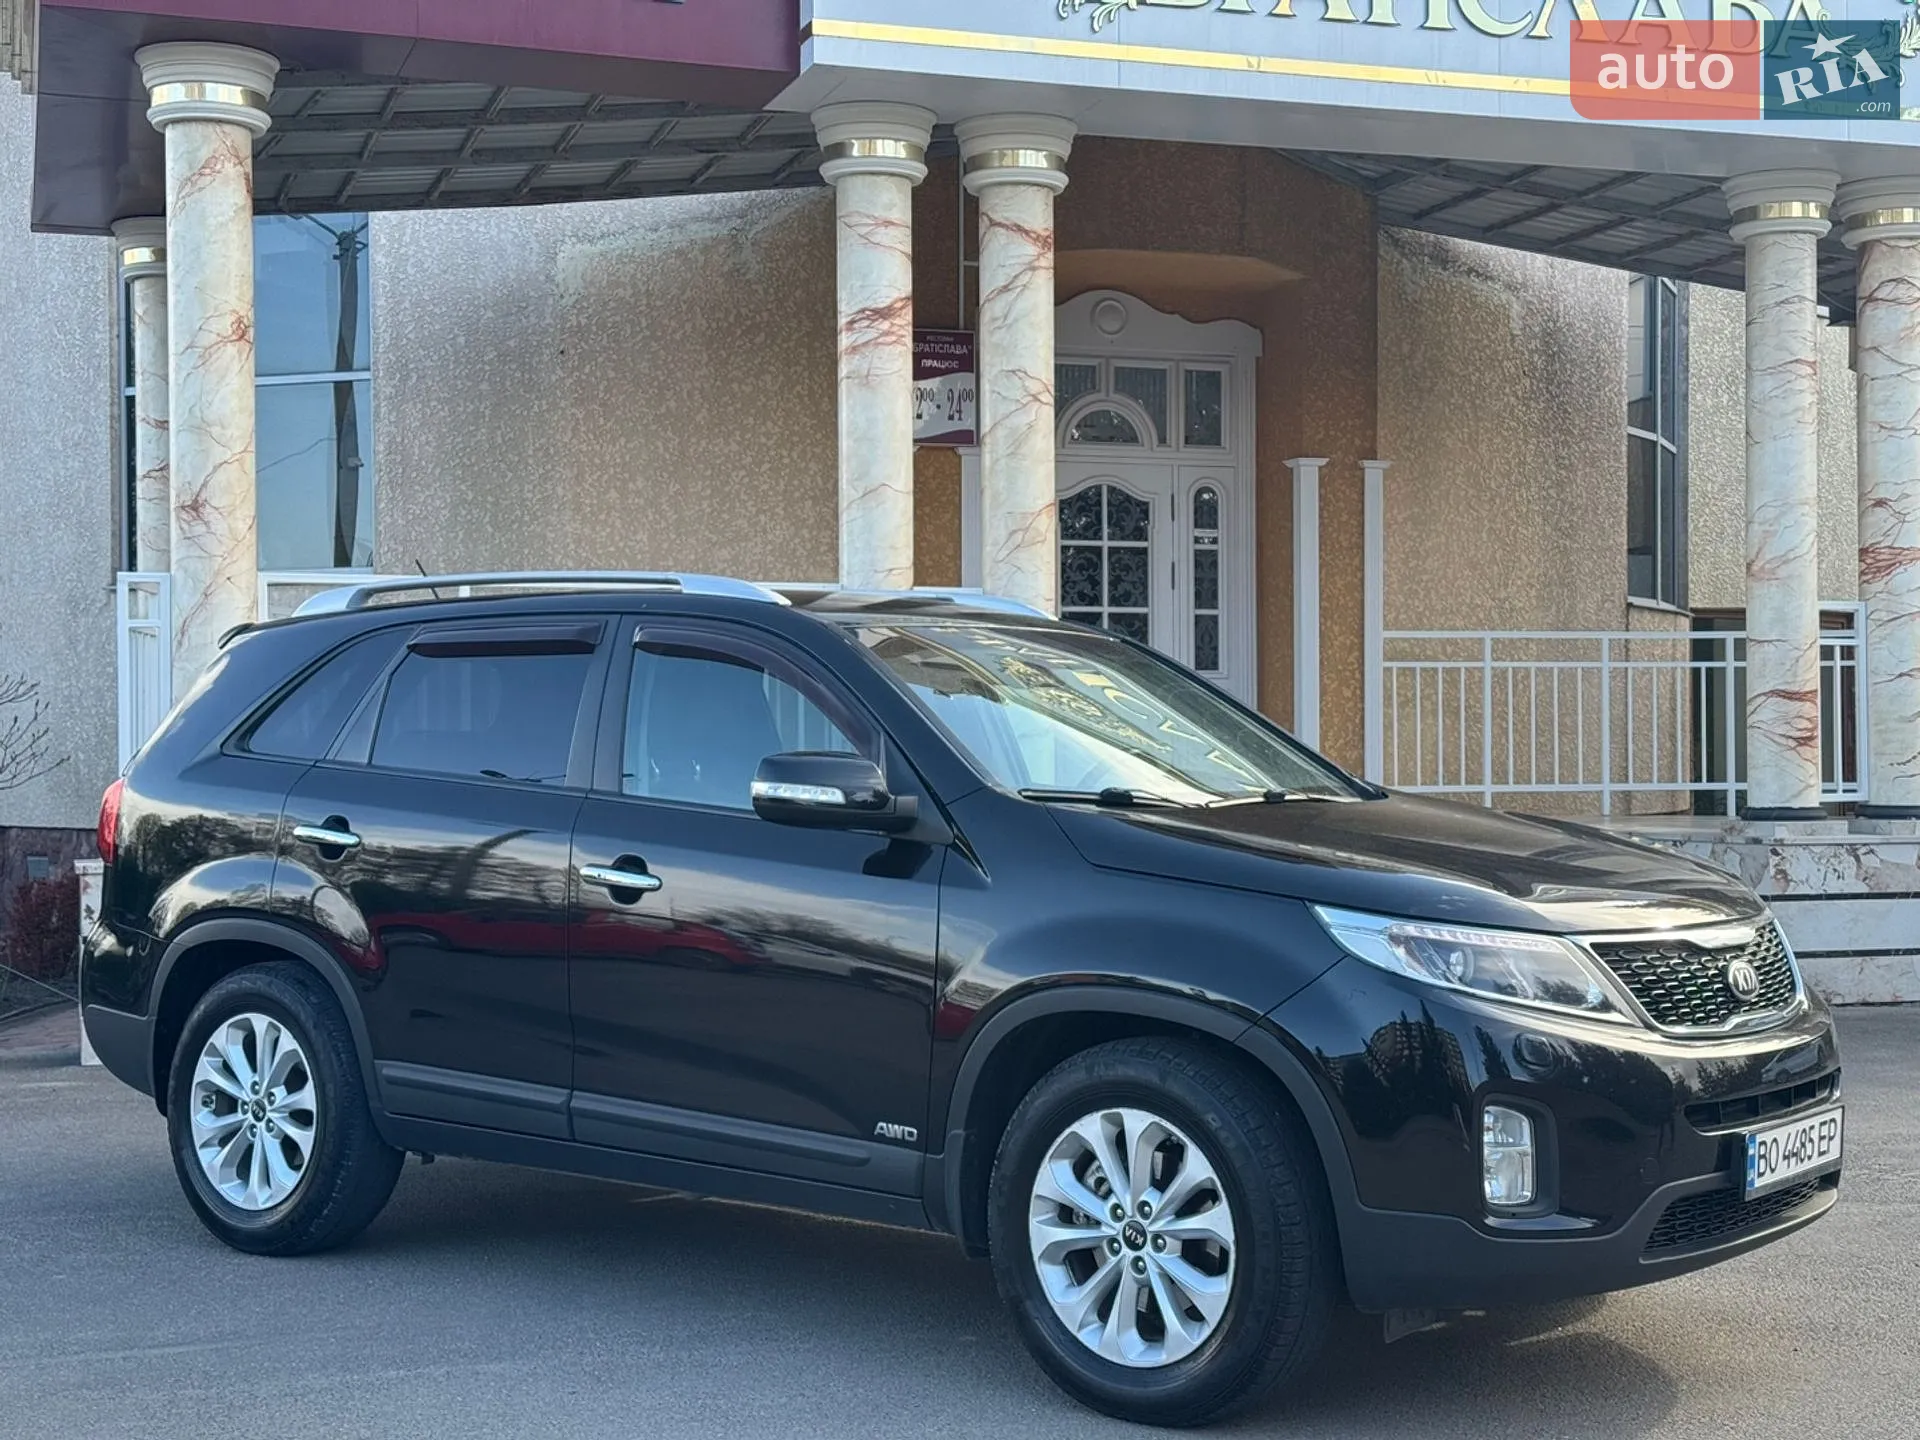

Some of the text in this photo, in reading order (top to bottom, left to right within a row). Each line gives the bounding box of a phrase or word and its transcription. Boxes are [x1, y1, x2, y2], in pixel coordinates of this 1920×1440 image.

[874, 1121, 918, 1142] AWD
[1757, 1117, 1838, 1179] BO 4485 EP
[1125, 1225, 1145, 1246] KIA
